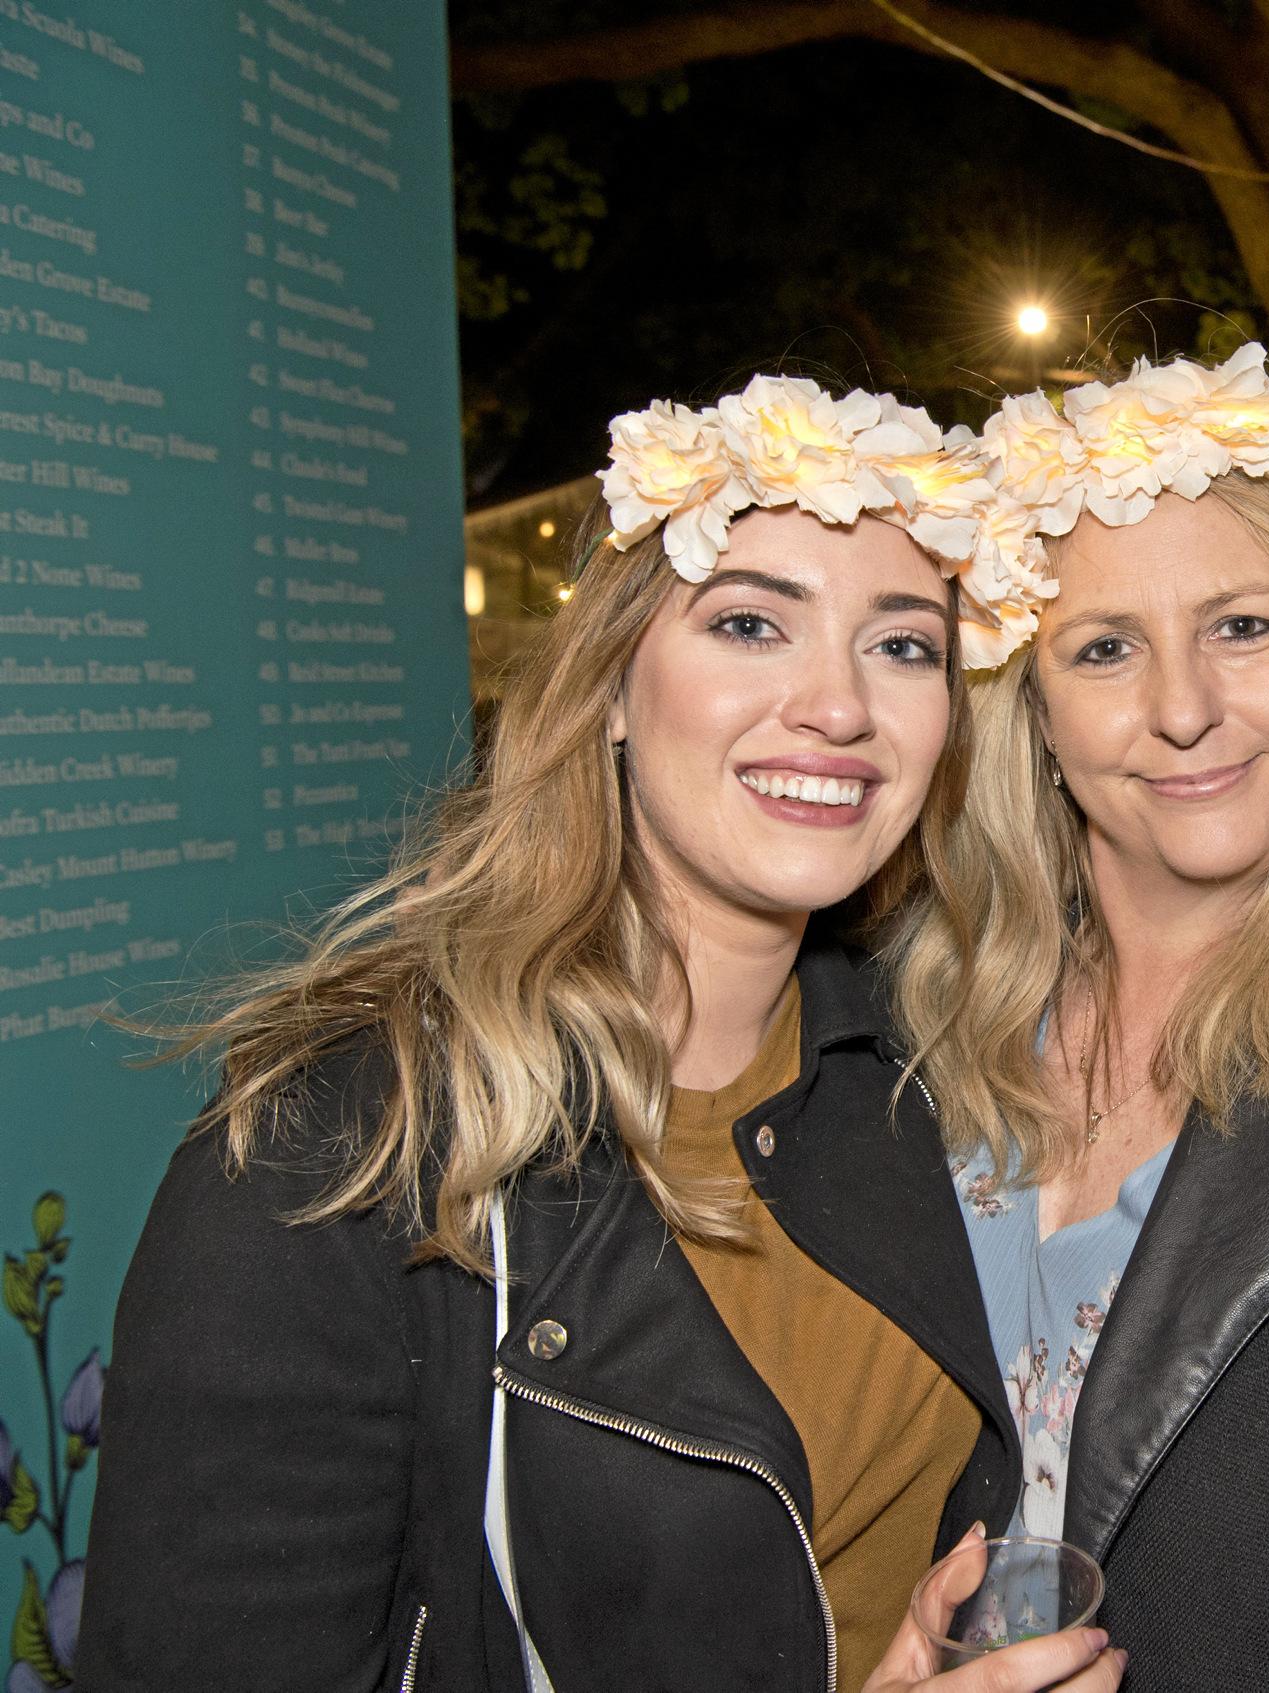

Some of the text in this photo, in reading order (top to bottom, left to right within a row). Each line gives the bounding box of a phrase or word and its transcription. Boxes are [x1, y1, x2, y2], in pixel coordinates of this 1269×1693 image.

[89, 30, 144, 74] Wines
[28, 112, 63, 139] and
[66, 121, 94, 150] Co
[25, 155, 84, 196] Wines
[13, 204, 96, 254] Catering
[36, 262, 93, 297] Grove
[97, 277, 151, 311] Estate
[35, 310, 87, 344] Tacos
[29, 360, 62, 393] Bay
[43, 413, 94, 444] Spice
[97, 423, 112, 446] &
[115, 426, 168, 459] Curry
[169, 434, 217, 462] House
[32, 460, 69, 488] Hill
[73, 467, 130, 495] Wines
[15, 509, 67, 537] Steak
[72, 515, 88, 538] It
[16, 560, 27, 584] 2
[32, 561, 82, 587] None
[86, 565, 142, 590] Wines
[83, 611, 148, 637] Cheese
[88, 661, 142, 684] Estate
[144, 661, 195, 683] Wines
[59, 754, 114, 782] Creek
[117, 753, 178, 778] Winery
[182, 839, 236, 861] Winery
[40, 898, 130, 932] Dumpling
[69, 950, 125, 976] House
[127, 938, 180, 961] Wines
